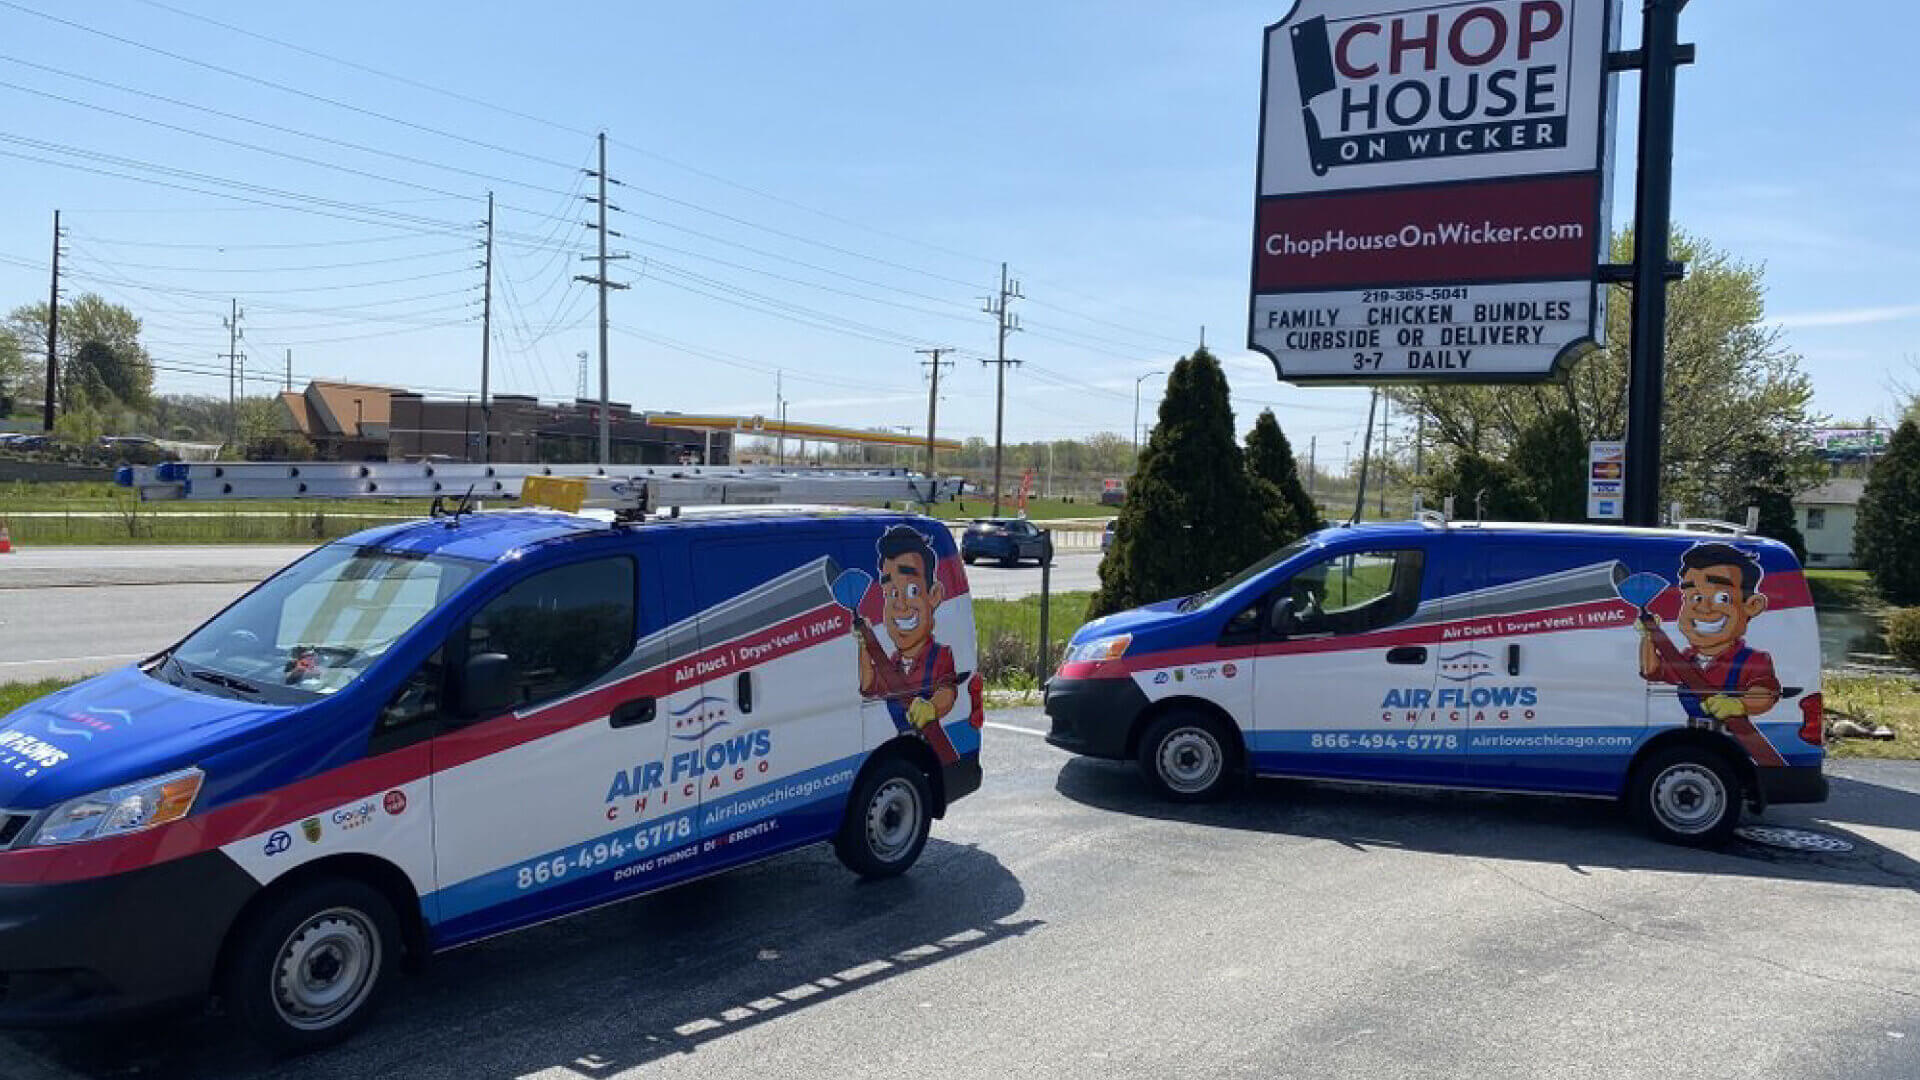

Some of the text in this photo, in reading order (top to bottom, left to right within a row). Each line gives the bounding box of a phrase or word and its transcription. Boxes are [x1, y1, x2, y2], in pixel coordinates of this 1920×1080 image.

[1334, 0, 1564, 80] CHOP
[1341, 64, 1557, 131] HOUSE
[1340, 123, 1553, 160] ON WICKER
[1265, 221, 1583, 258] ChopHouseOnWicker.com
[1362, 287, 1468, 303] 219-365-5041
[1268, 302, 1571, 329] FAMILY CHICKEN BUNDLES
[1286, 325, 1545, 349] CURBSIDE OR DELIVERY
[1353, 351, 1472, 371] 3-7 DAILY
[1443, 627, 1461, 639] Air
[1463, 624, 1494, 636] Duct
[1543, 616, 1575, 628] Vent
[1587, 609, 1625, 623] HVAC
[675, 666, 695, 683] Air
[697, 655, 728, 675] Duct
[810, 615, 842, 636] HVAC
[1381, 687, 1537, 708] AIR FLOWS
[1382, 710, 1535, 721] CHICAGO
[1311, 733, 1457, 749] 866-494-6778
[606, 729, 771, 803] AIR FLOWS
[606, 760, 769, 820] CHICAGO
[517, 816, 691, 889] 866-494-6778
[614, 819, 779, 881] DOING THINGS DIERENTLY.
